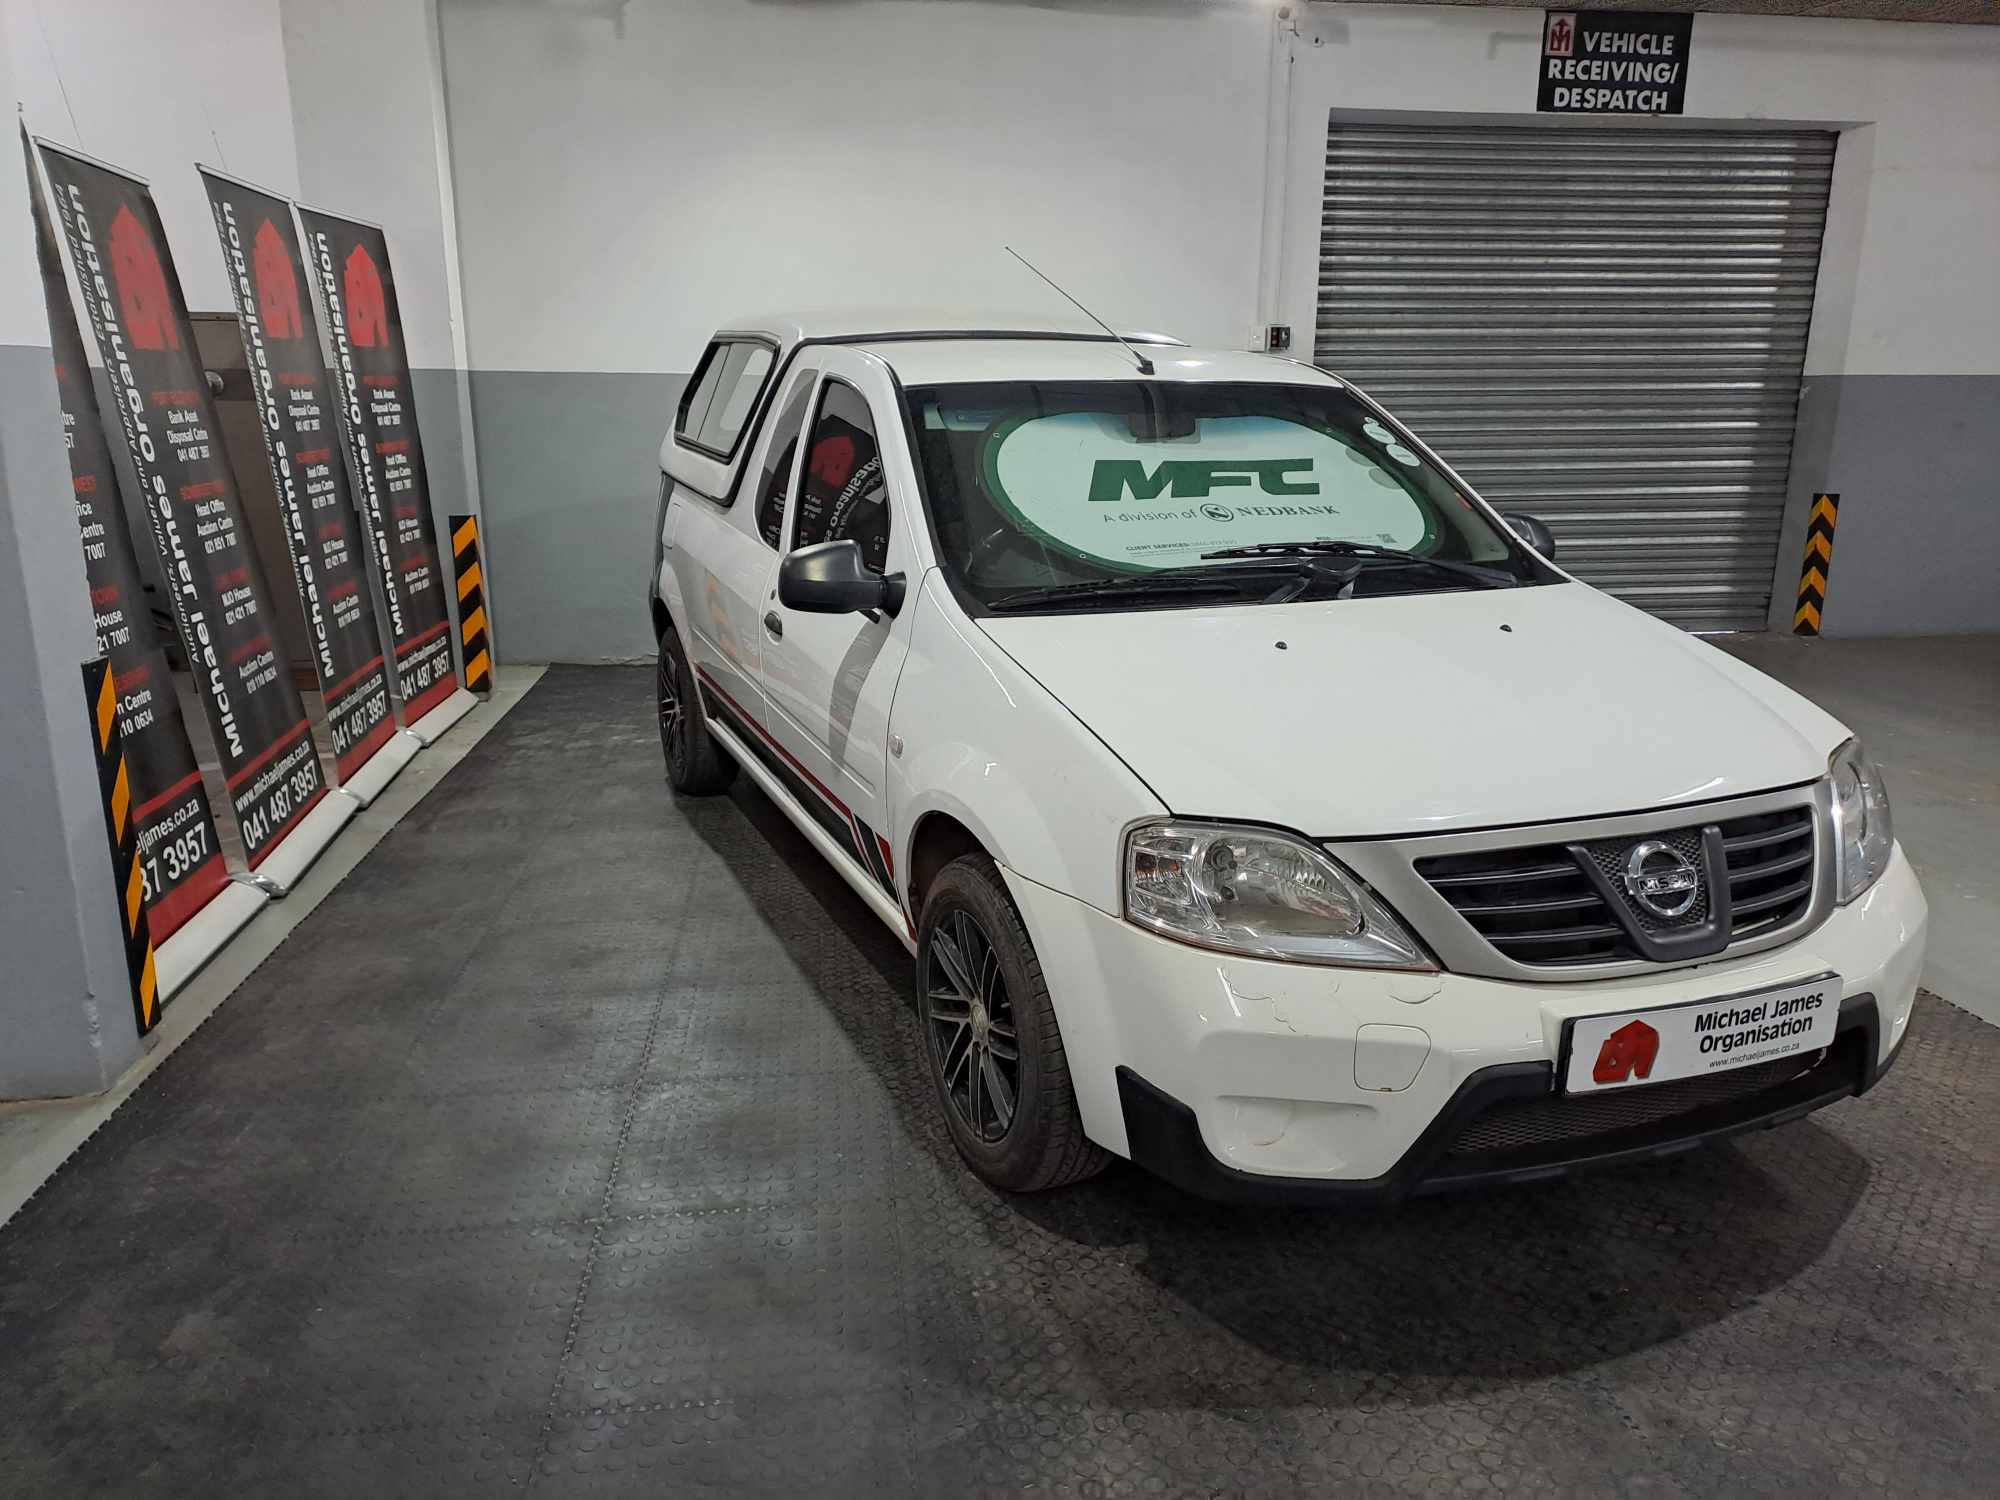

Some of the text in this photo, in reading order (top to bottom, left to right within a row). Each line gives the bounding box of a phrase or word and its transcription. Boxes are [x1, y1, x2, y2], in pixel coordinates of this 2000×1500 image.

[1548, 58, 1680, 84] RECEIVING/
[1583, 31, 1674, 55] VEHICLE
[1553, 87, 1668, 111] DESPATCH
[68, 184, 156, 462] Organisation
[223, 202, 280, 430] Organisation
[316, 232, 361, 425] Organisation
[276, 440, 306, 546] James
[357, 433, 382, 523] James
[1088, 458, 1320, 501] MFC
[80, 522, 105, 538] entre
[152, 474, 198, 601] James
[1104, 505, 1341, 523] A division of NEDBANK
[375, 530, 404, 636] Michael
[299, 555, 335, 678] Michael
[125, 689, 152, 711] Centre
[190, 611, 243, 758] Michael
[400, 650, 449, 700] 041 487 3957
[331, 690, 387, 755] 041 487 3957
[242, 759, 318, 850] 041 487 3957
[163, 822, 208, 880] 3957
[1694, 992, 1824, 1033] Michael James
[1699, 1015, 1813, 1054] Organisation
